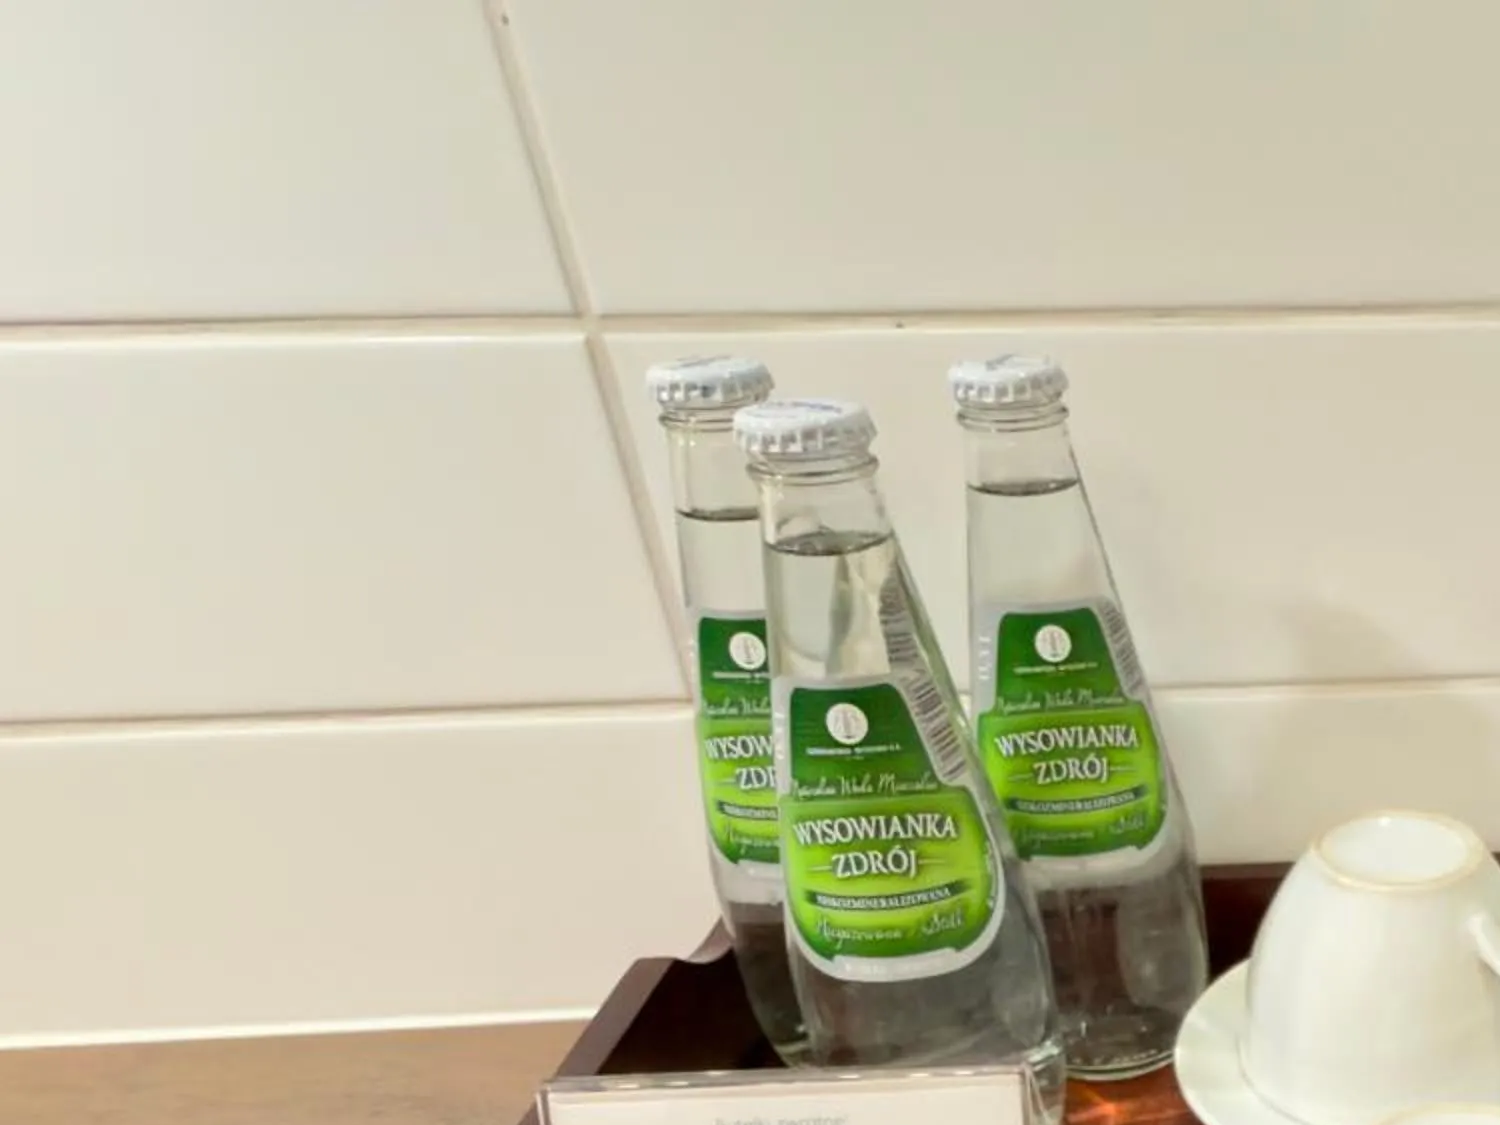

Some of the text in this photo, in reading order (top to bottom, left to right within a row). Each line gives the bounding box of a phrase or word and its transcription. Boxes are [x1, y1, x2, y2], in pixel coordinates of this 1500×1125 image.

[994, 724, 1139, 758] WYSOWIANKA
[1033, 754, 1109, 784] ZDRÓJ
[793, 813, 959, 846] WYSOWIANKA
[831, 845, 917, 879] ZDRÓJ
